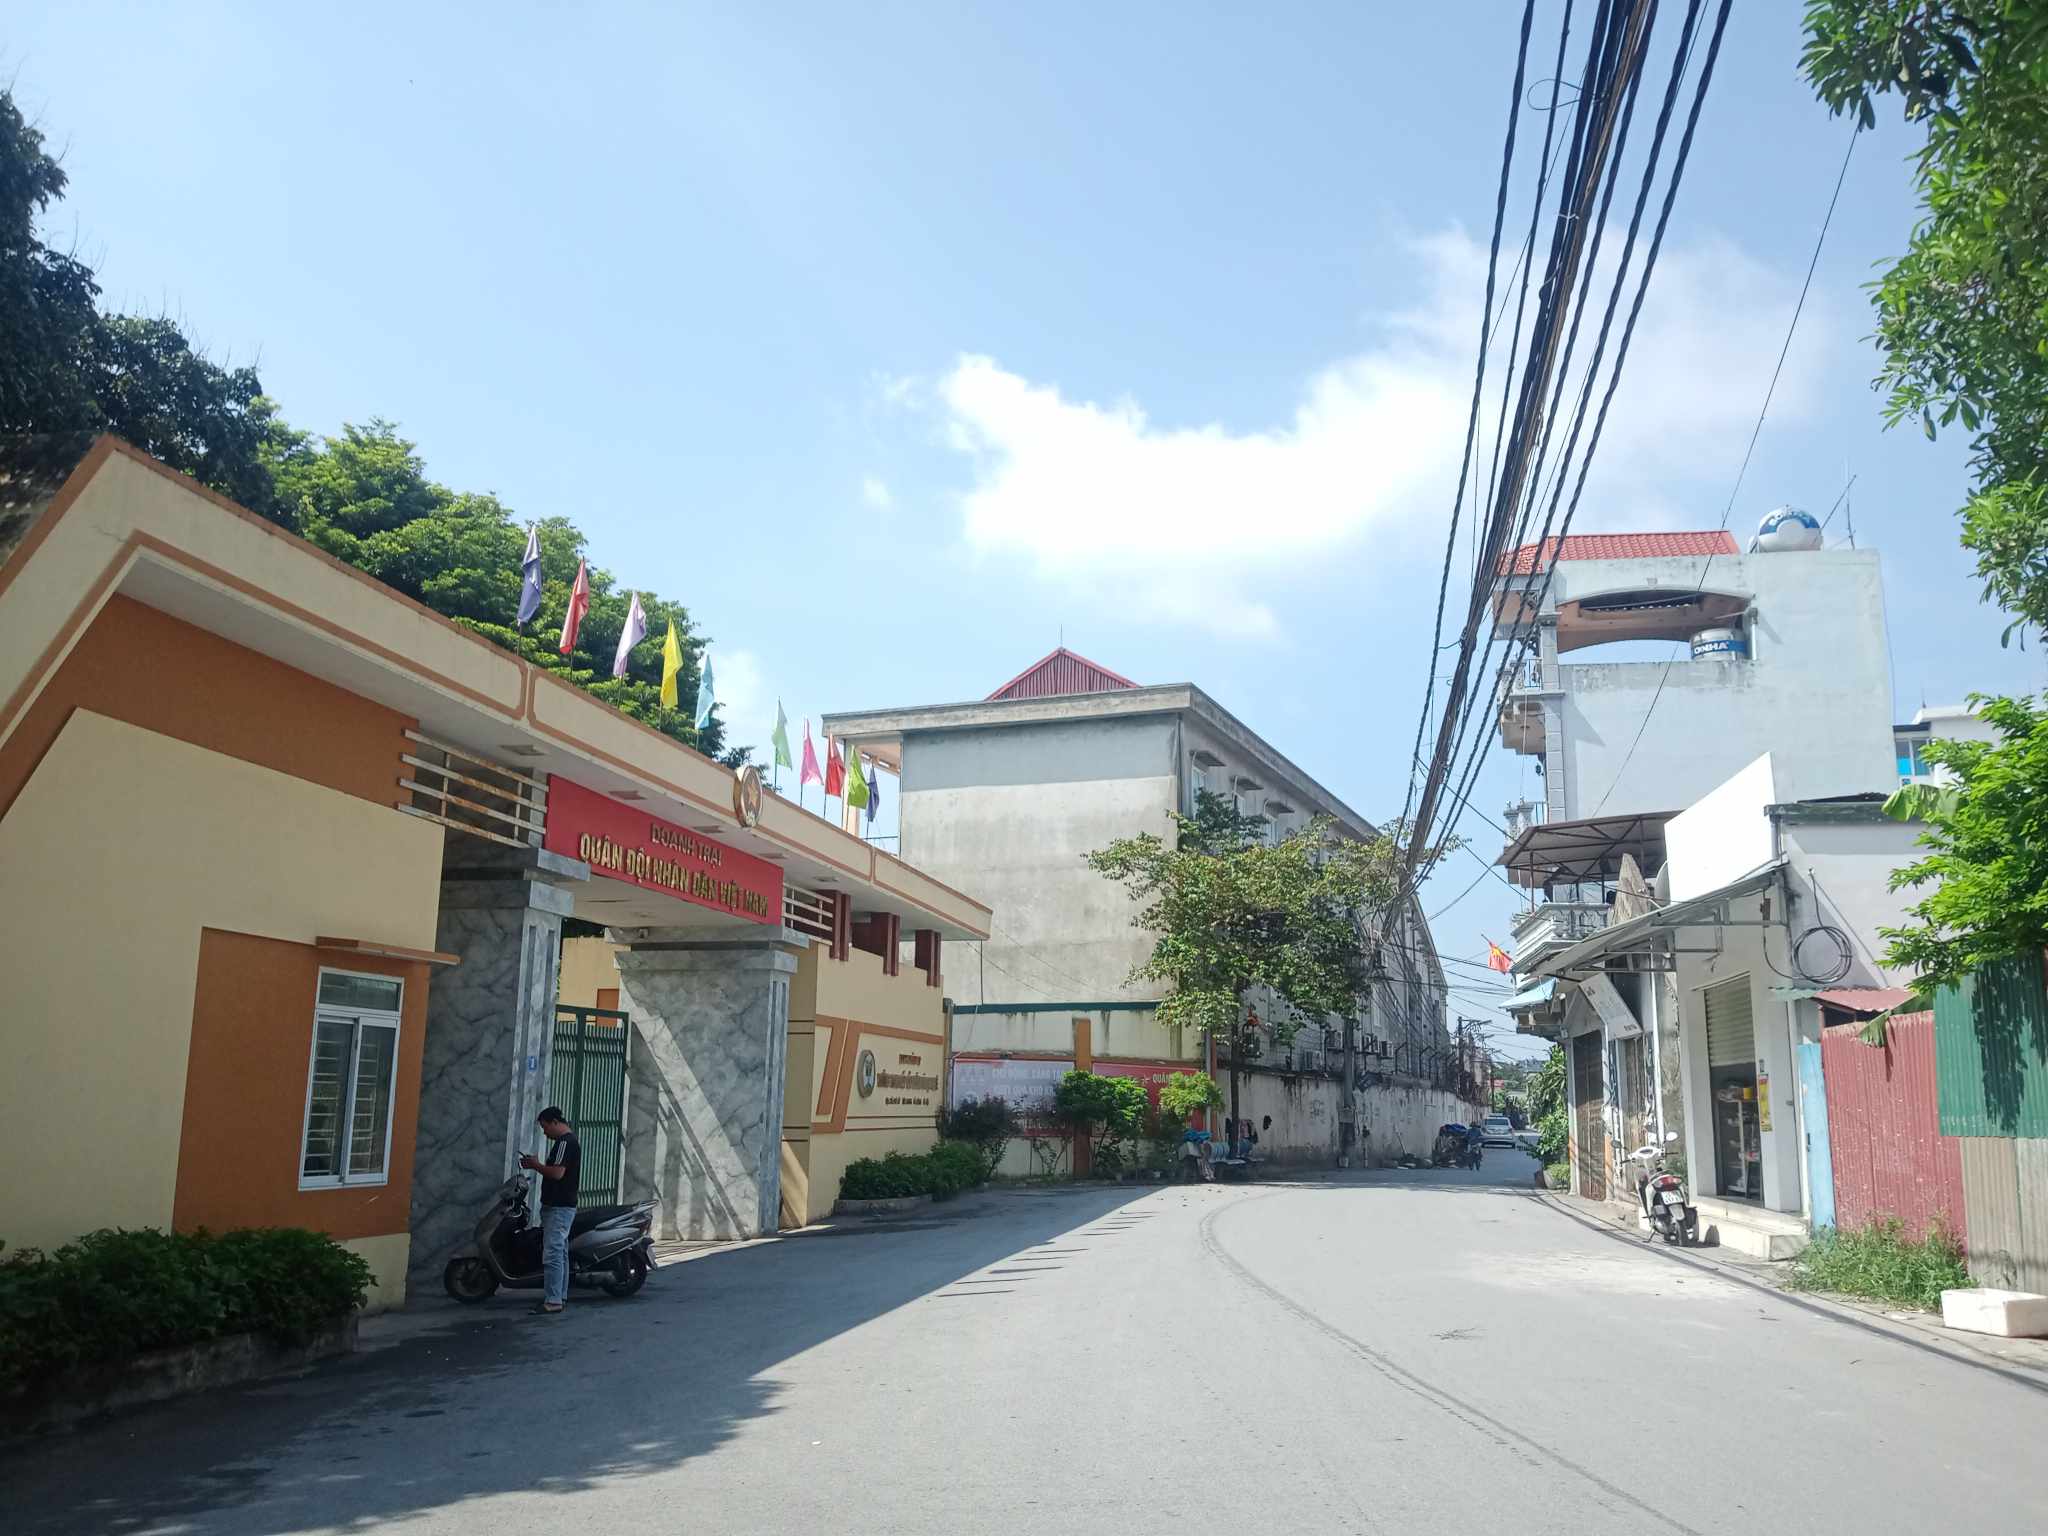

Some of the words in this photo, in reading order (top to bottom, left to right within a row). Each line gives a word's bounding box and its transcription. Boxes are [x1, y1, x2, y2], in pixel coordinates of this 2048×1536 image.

[580, 832, 623, 872] QUÂN
[626, 849, 651, 884] ĐỘI
[653, 856, 690, 893] NHÂN
[652, 824, 695, 856] DOANH
